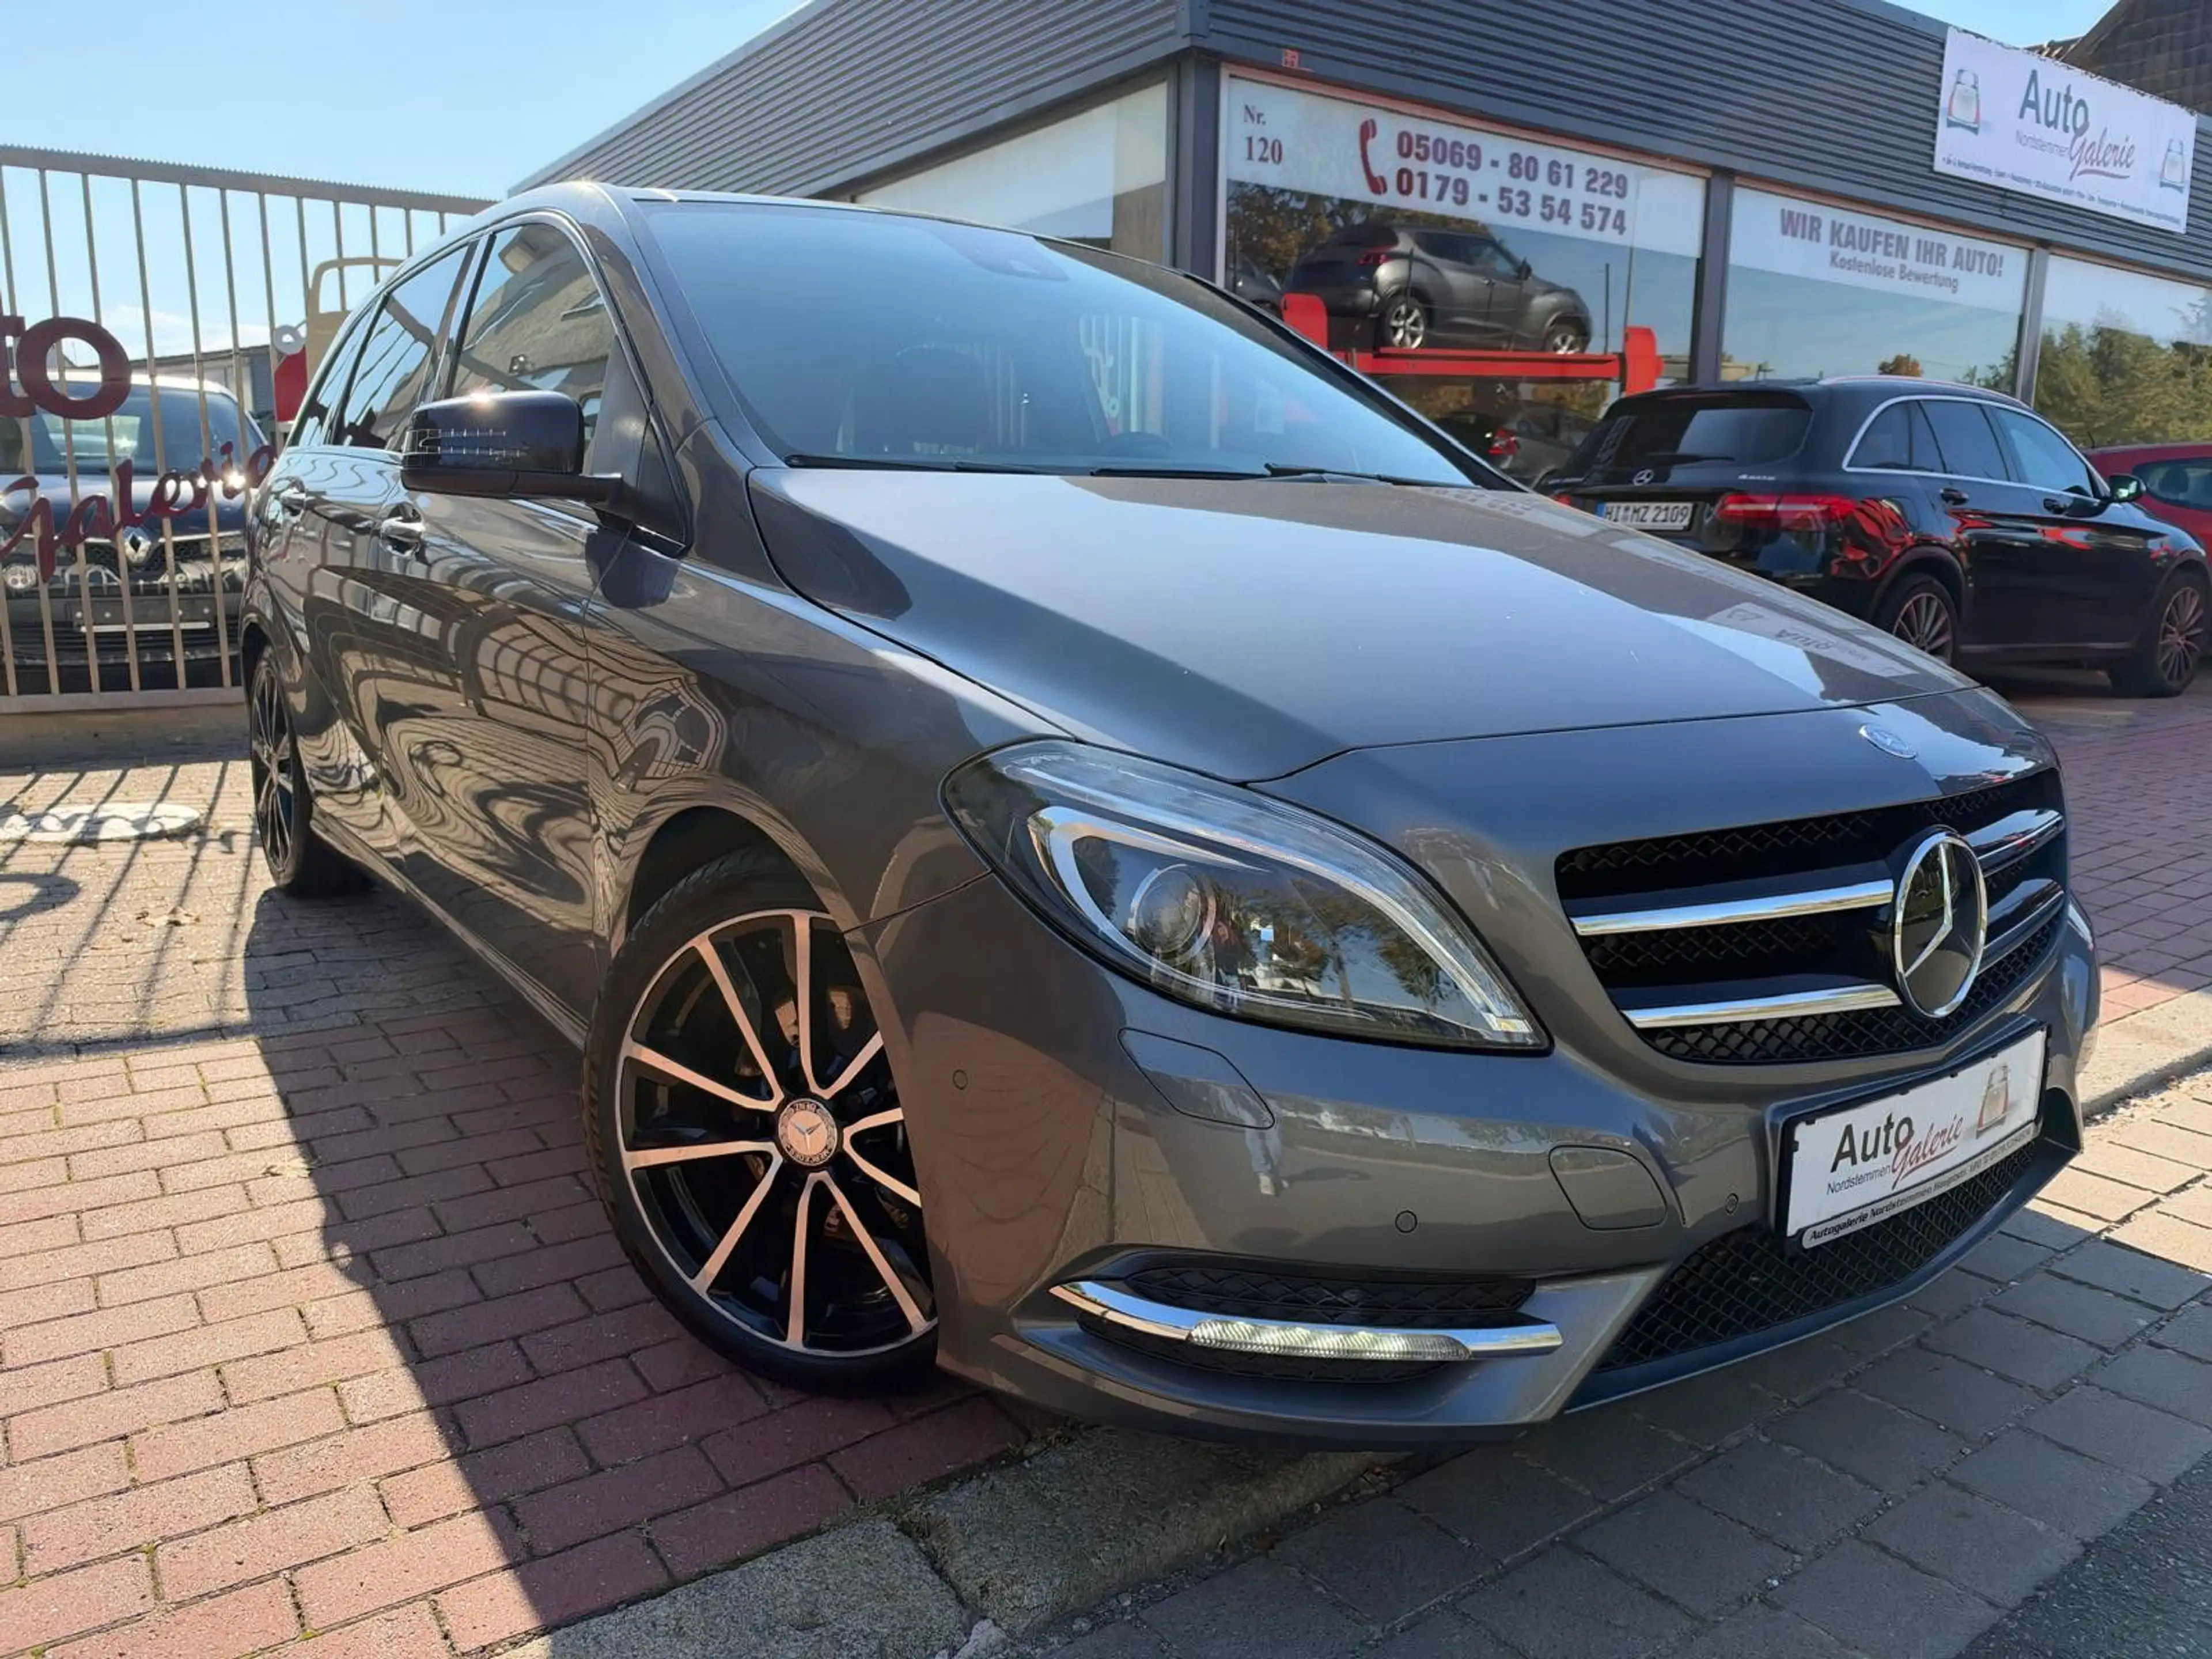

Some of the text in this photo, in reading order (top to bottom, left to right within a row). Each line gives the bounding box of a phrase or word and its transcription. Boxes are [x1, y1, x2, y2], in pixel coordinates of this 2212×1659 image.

[1244, 104, 1266, 125] Nr.
[2018, 69, 2089, 133] Auto
[1245, 136, 1283, 165] 120
[1397, 130, 1482, 171] 05069
[1508, 152, 1540, 181] 80
[1547, 160, 1574, 188] 61
[1585, 168, 1628, 199] 229
[2069, 122, 2135, 181] Galerie
[1396, 167, 1469, 206] 0179
[1498, 187, 1531, 217] 53
[1540, 195, 1572, 226] 54
[1581, 203, 1627, 236] 574
[1780, 208, 2005, 278] WIR KAUFEN IHR AUTO!
[1830, 251, 1960, 294] Kostenlose Bewertung
[1630, 506, 1650, 522] MZ
[1651, 505, 1689, 523] 2109
[1830, 1112, 1914, 1173] Auto
[1891, 1113, 1964, 1190] Galerie
[1827, 1165, 1891, 1195] Nordstemmen
[1810, 1211, 1869, 1241] Autogalerie
